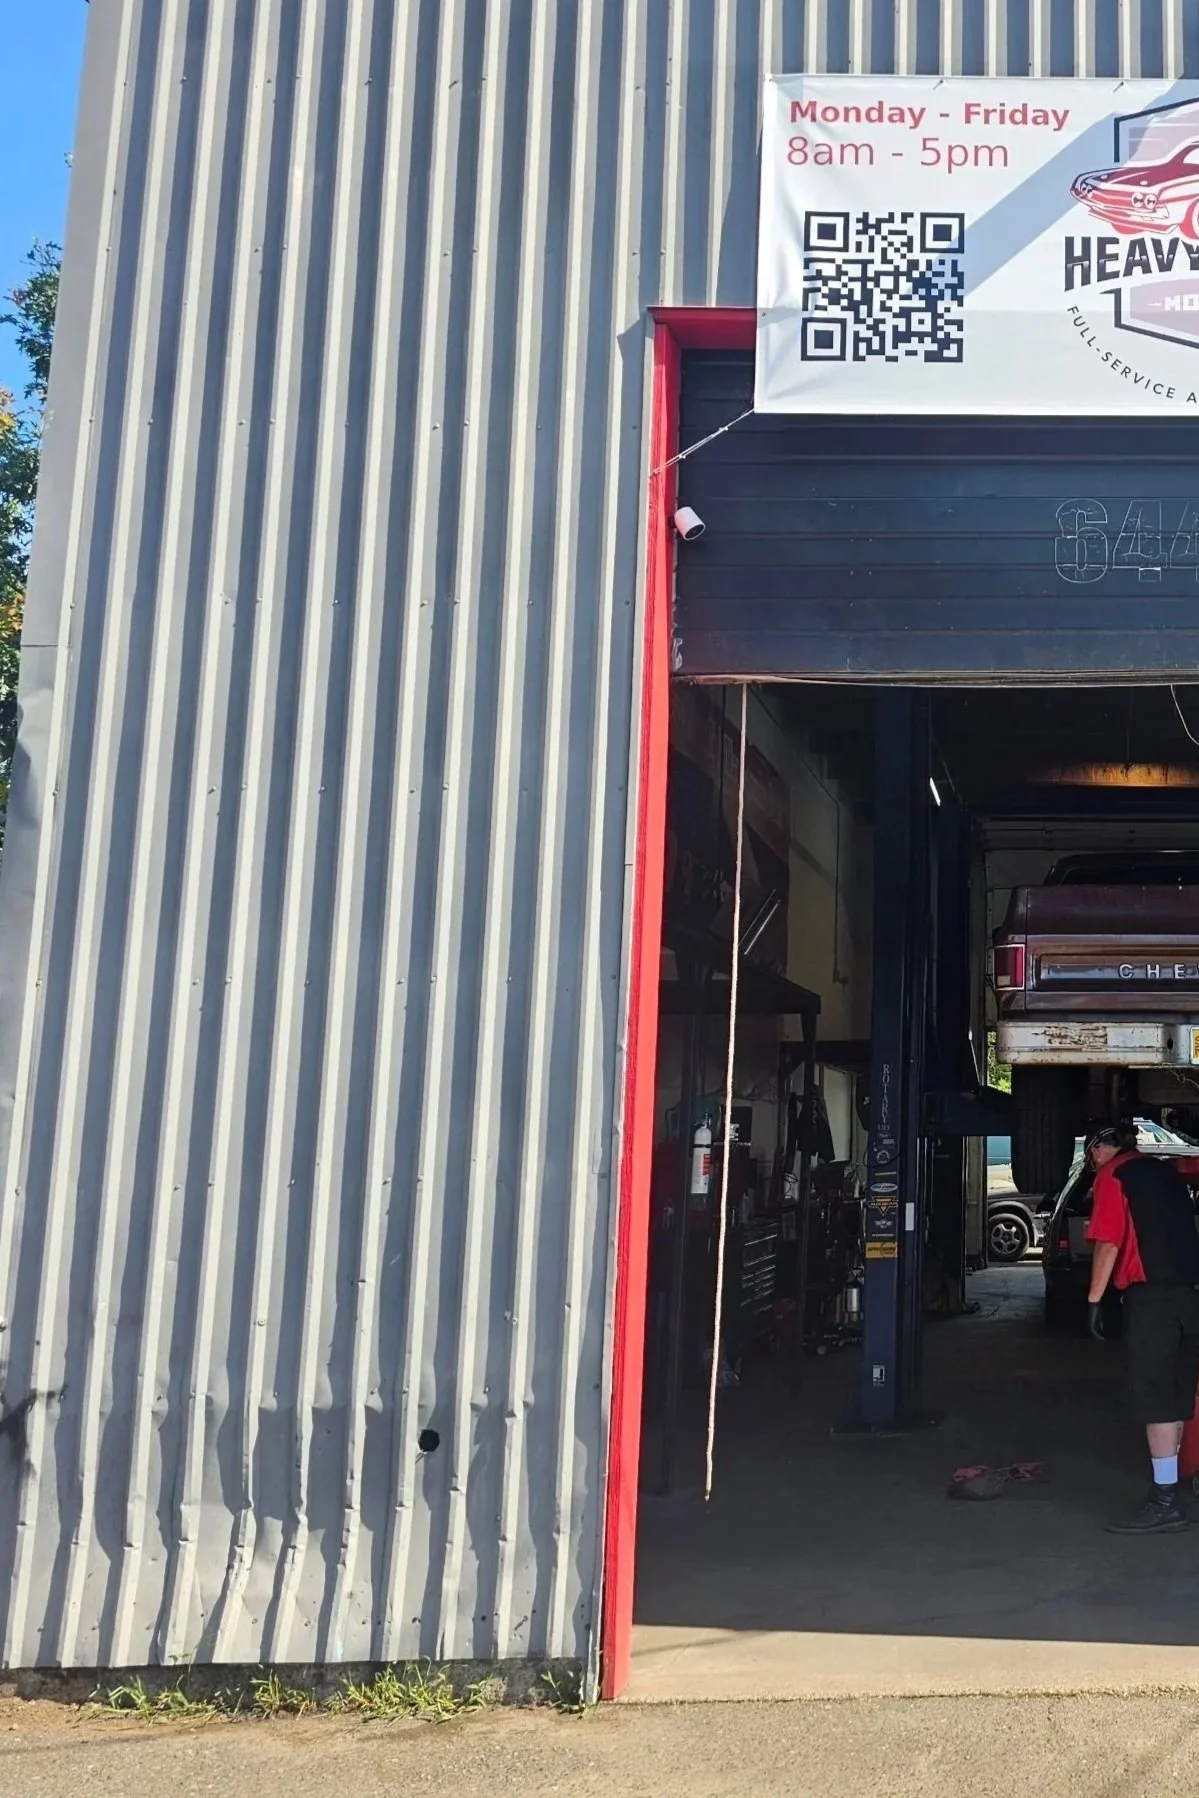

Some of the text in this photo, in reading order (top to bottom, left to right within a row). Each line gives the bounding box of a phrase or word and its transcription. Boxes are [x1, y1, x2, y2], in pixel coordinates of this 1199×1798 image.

[789, 100, 926, 129] Monday
[963, 102, 1070, 132] Friday
[786, 136, 874, 166] 8am
[920, 137, 1009, 174] 5pm
[1066, 305, 1176, 400] FULL-SERVICE
[881, 1063, 890, 1124] ROTARY
